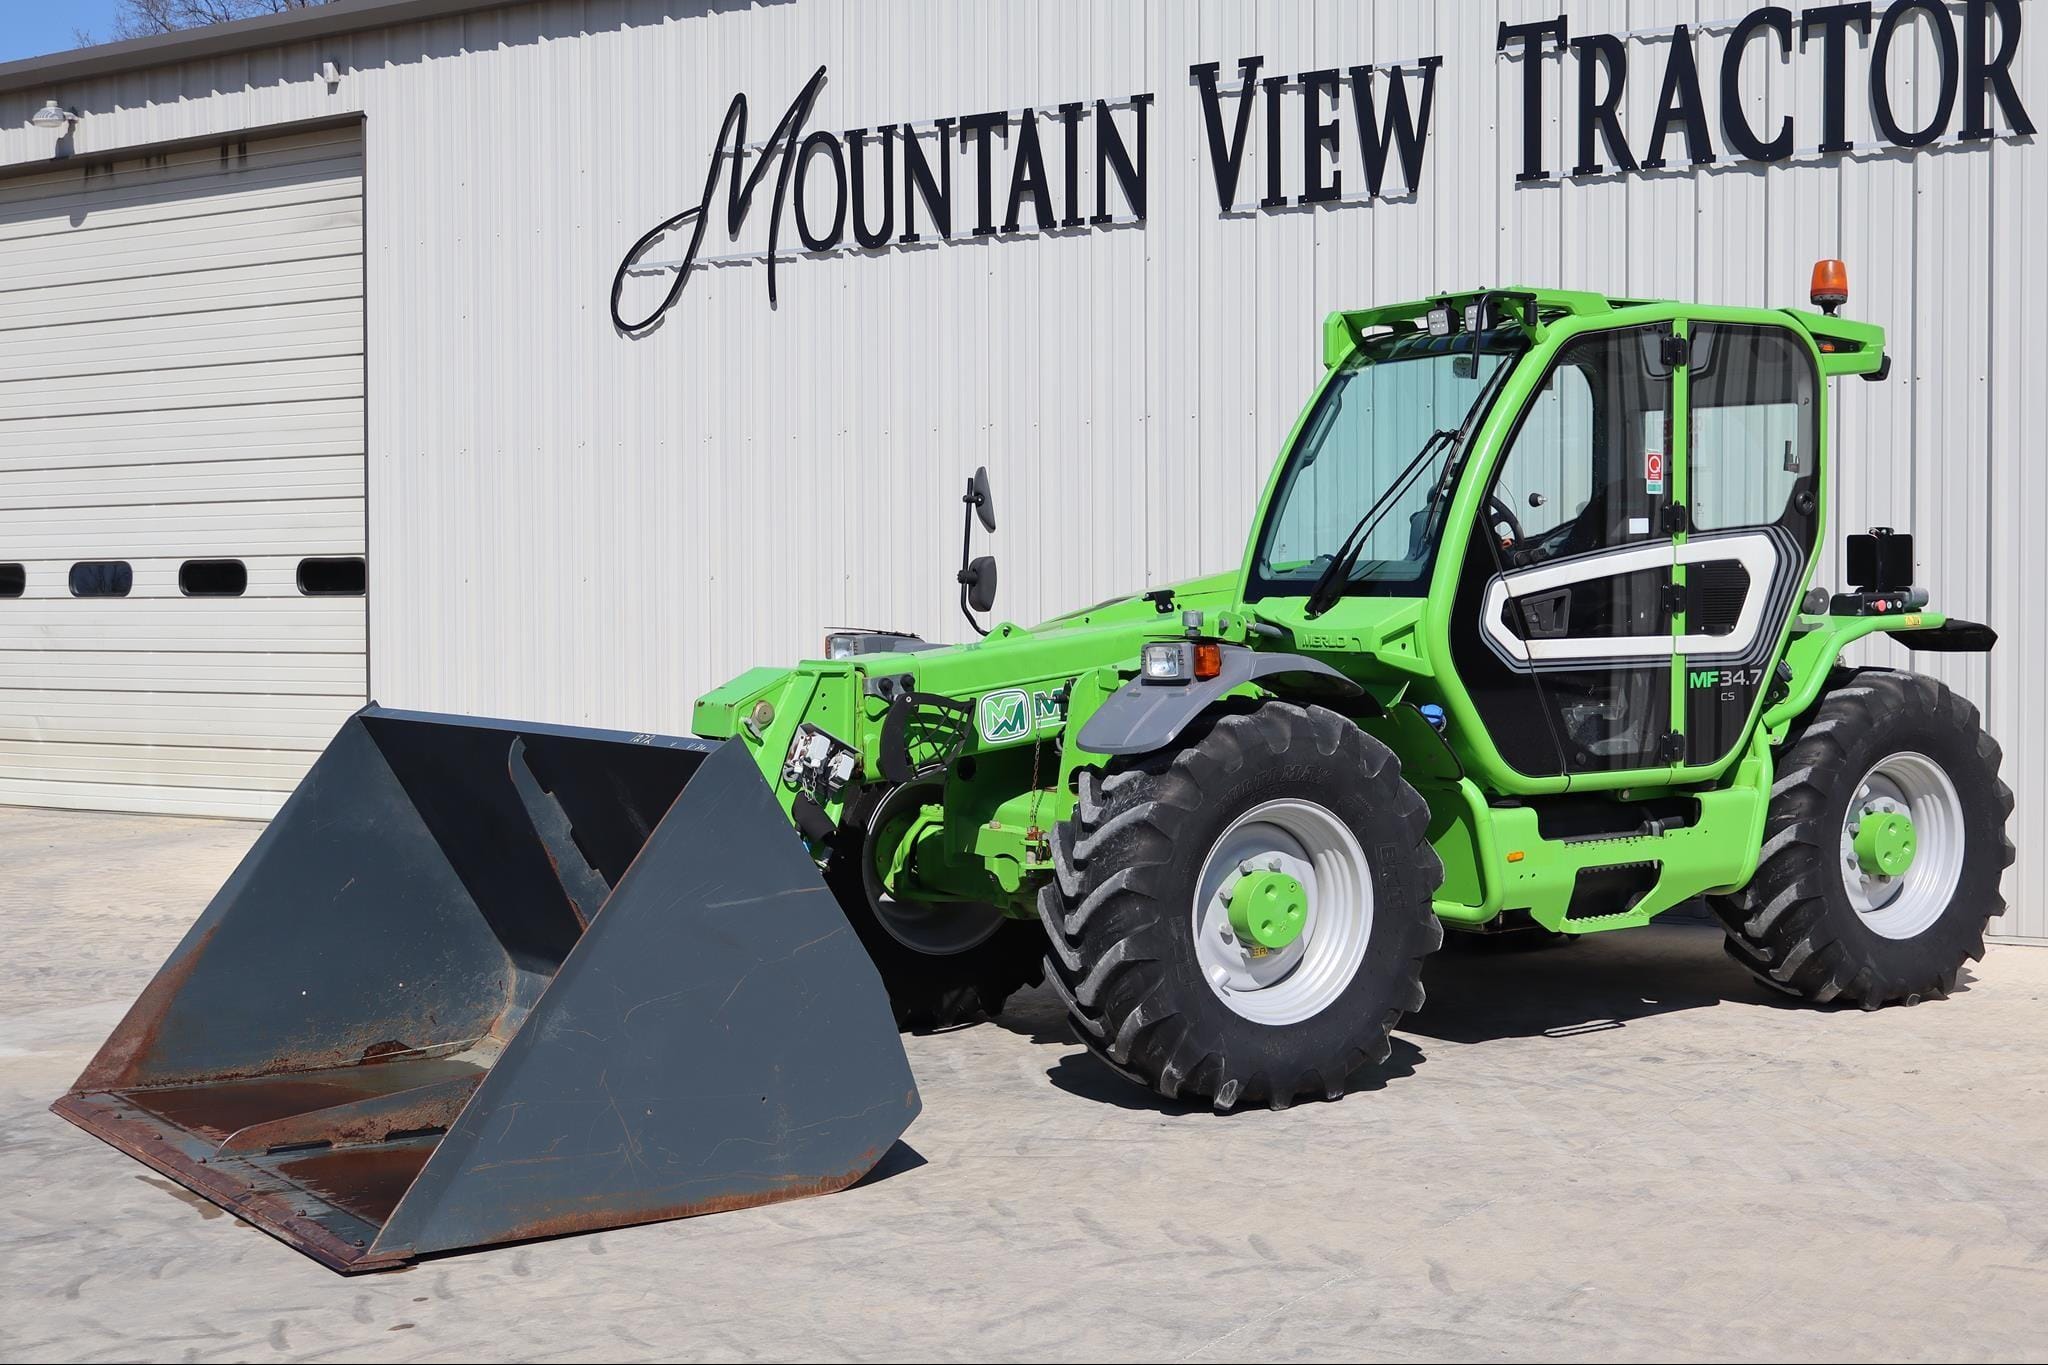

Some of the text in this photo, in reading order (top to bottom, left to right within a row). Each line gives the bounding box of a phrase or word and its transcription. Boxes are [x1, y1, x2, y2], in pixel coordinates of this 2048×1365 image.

[610, 0, 2037, 331] MOUNTAIN VIEW TRACTOR
[1720, 692, 1736, 701] CS
